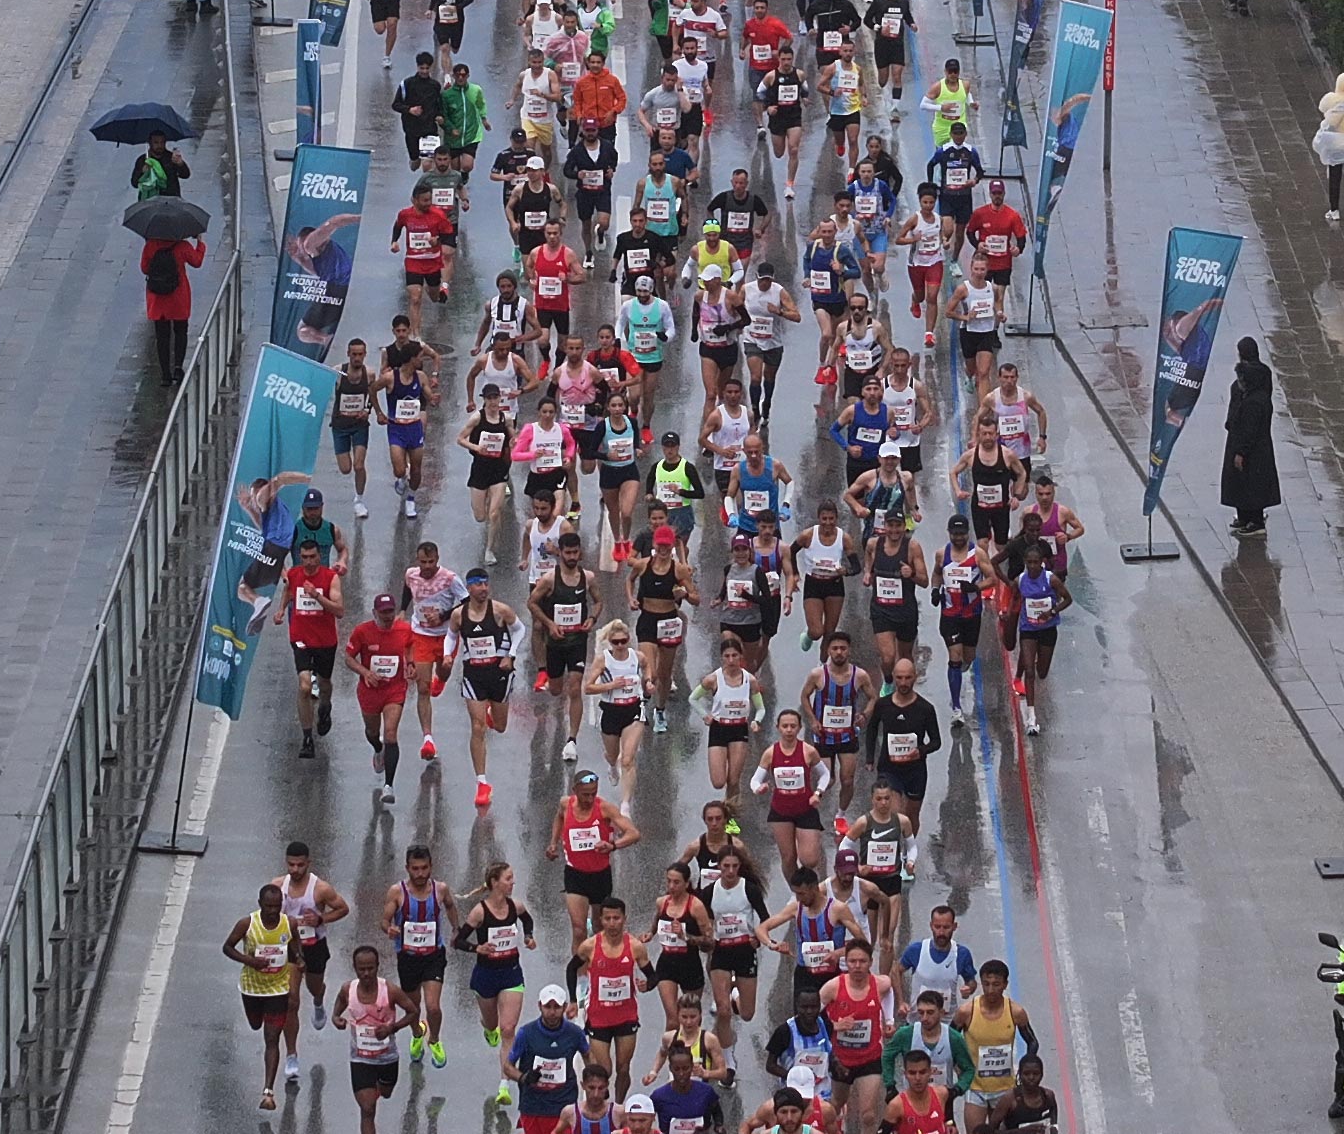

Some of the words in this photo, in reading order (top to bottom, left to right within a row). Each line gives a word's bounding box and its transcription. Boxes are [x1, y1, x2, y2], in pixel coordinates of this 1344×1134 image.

[1064, 33, 1100, 50] KONYA
[301, 173, 348, 188] SPOR
[301, 183, 357, 203] KONYA
[1176, 256, 1221, 275] SPOR
[292, 277, 327, 288] KONYA
[1174, 266, 1226, 288] KONYA
[283, 291, 343, 306] MARATONU
[302, 286, 326, 295] YARI
[265, 373, 311, 399] SPOR
[262, 383, 317, 418] KONYA
[235, 526, 265, 544] KONYA
[227, 539, 277, 566] MARATONU
